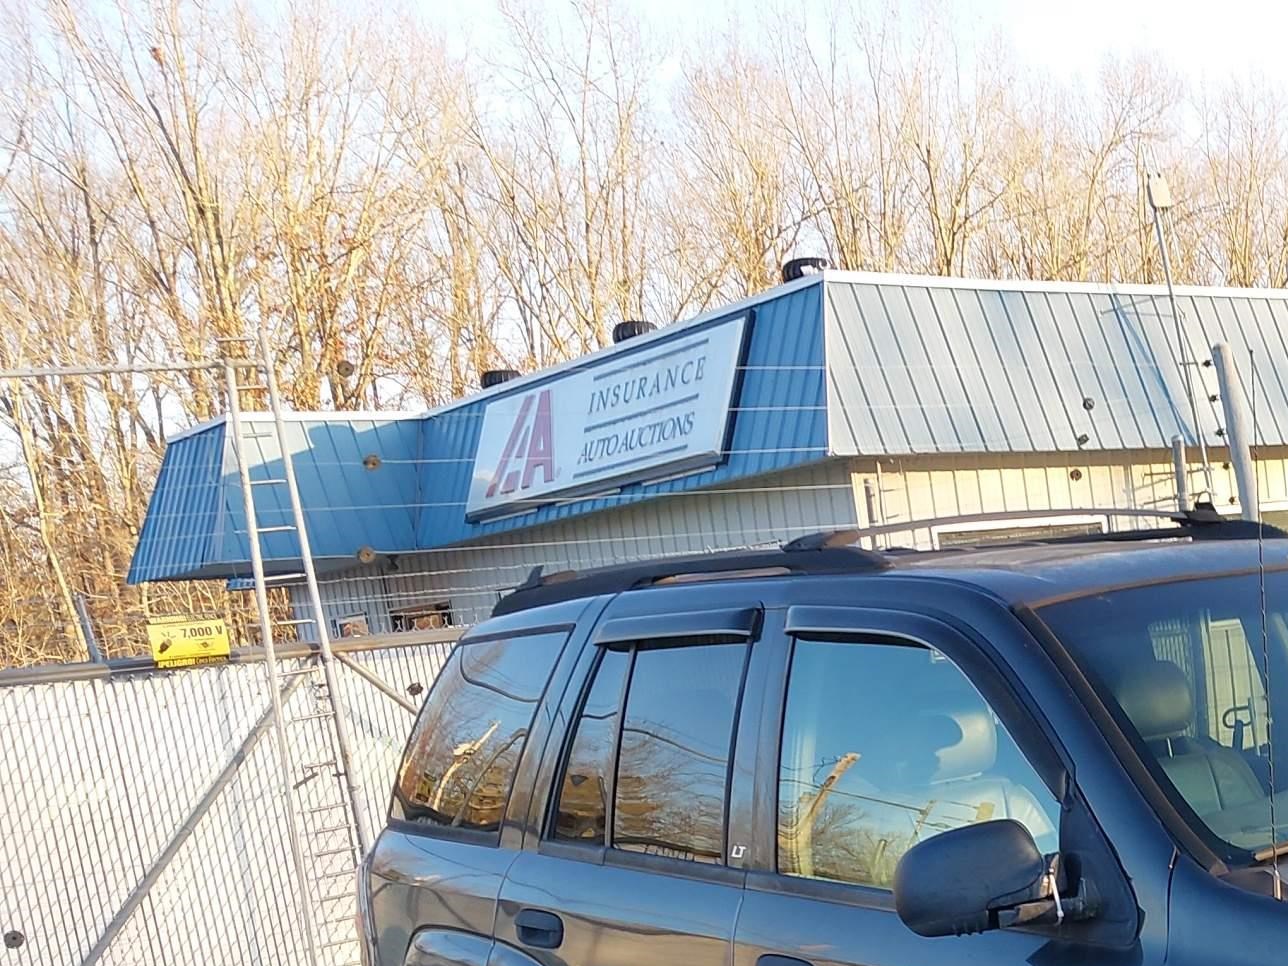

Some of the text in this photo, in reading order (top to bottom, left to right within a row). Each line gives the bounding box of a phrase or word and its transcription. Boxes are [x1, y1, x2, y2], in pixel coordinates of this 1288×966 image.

[587, 355, 707, 416] INSURANCE
[616, 412, 695, 450] AUCTIONS
[180, 625, 223, 640] 7,000 V
[731, 845, 747, 858] LT
